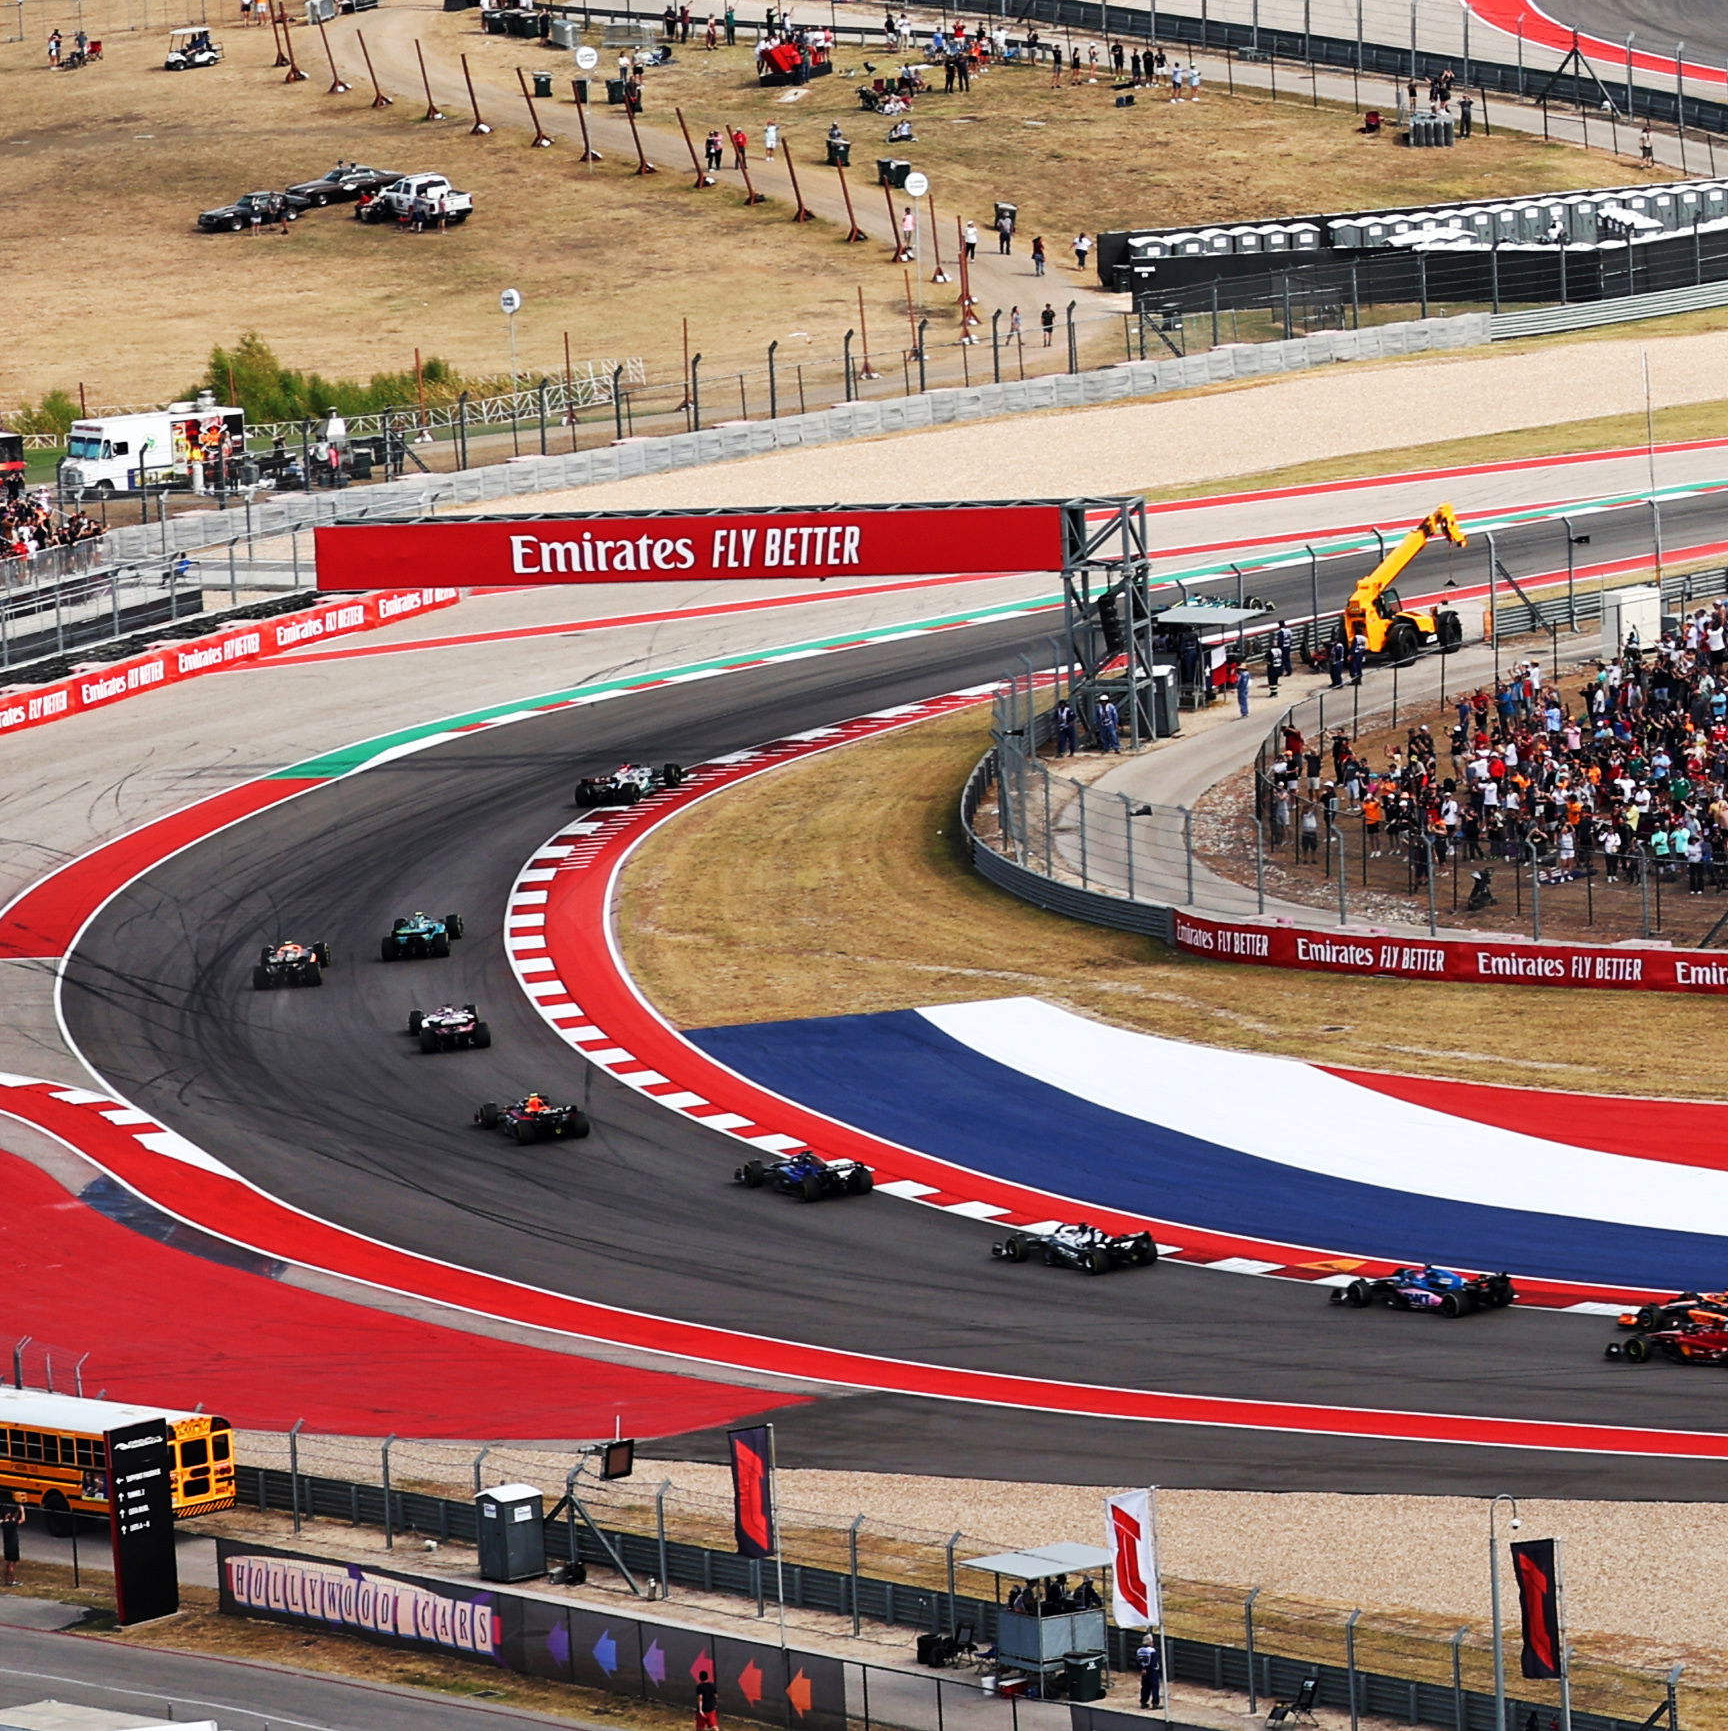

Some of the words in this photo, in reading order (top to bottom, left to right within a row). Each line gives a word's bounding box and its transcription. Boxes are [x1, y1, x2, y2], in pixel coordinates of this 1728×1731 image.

[510, 532, 694, 573] Emirates
[713, 529, 756, 567] FLY
[765, 526, 859, 566] BETTER
[379, 590, 421, 619] Emirates
[276, 617, 323, 646] Emirates
[1297, 937, 1374, 966] Emirates
[1379, 945, 1400, 969] FLY
[1401, 947, 1445, 972] BETTER
[1478, 953, 1564, 976] Emirates
[1572, 956, 1591, 978] FLY
[1596, 958, 1641, 980] BETTER
[235, 1563, 390, 1625] HOLLYWOOD
[421, 1599, 488, 1645] CARS
